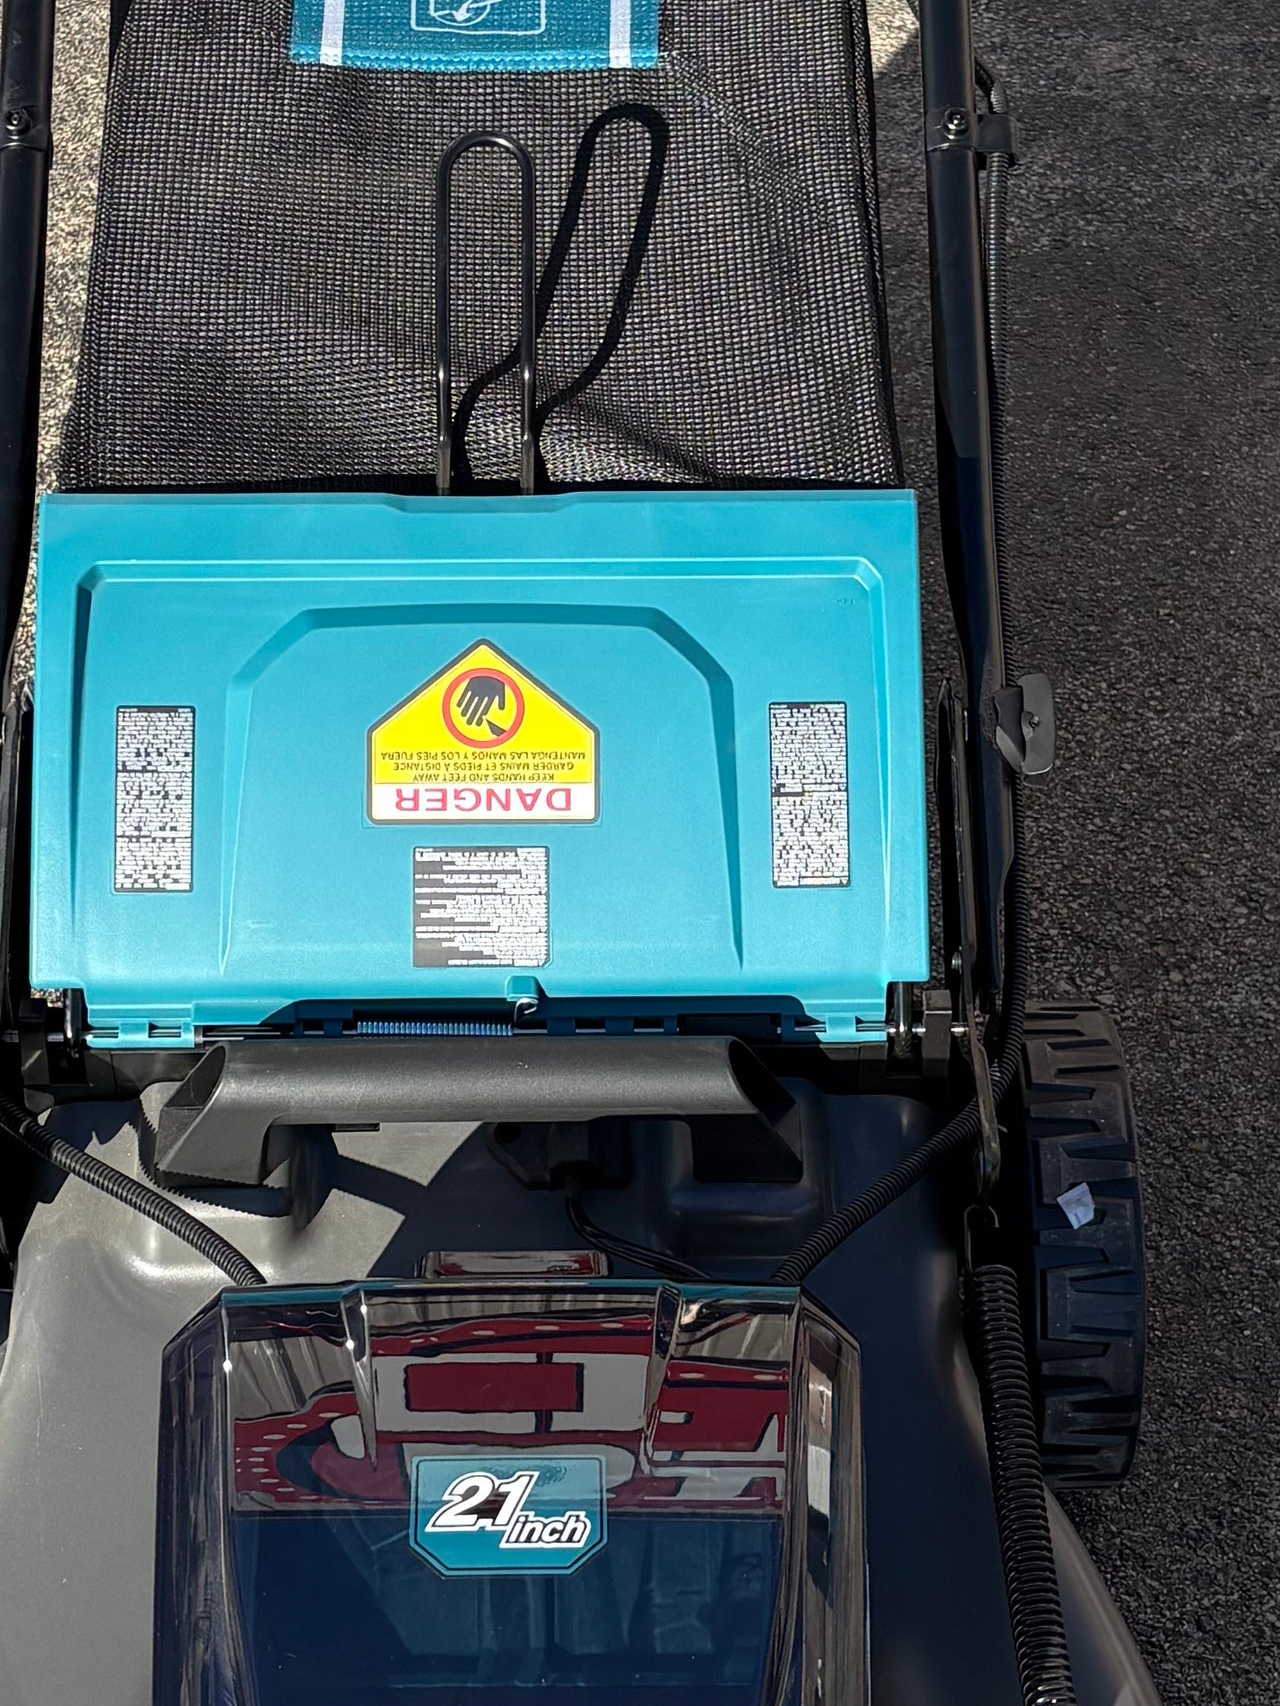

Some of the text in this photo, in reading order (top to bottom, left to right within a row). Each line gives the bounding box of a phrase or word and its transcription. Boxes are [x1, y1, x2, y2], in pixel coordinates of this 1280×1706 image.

[381, 752, 585, 760] MANTENGA LAS MANOS Y LOS PIES FUERA
[394, 762, 573, 773] GARDER MAINS ET PIEDS À DISTANCE
[413, 773, 554, 781] KEEP HANDS AND FEET AWAY
[395, 788, 571, 811] DANGER
[424, 1471, 540, 1532] 21
[500, 1511, 591, 1548] inch
